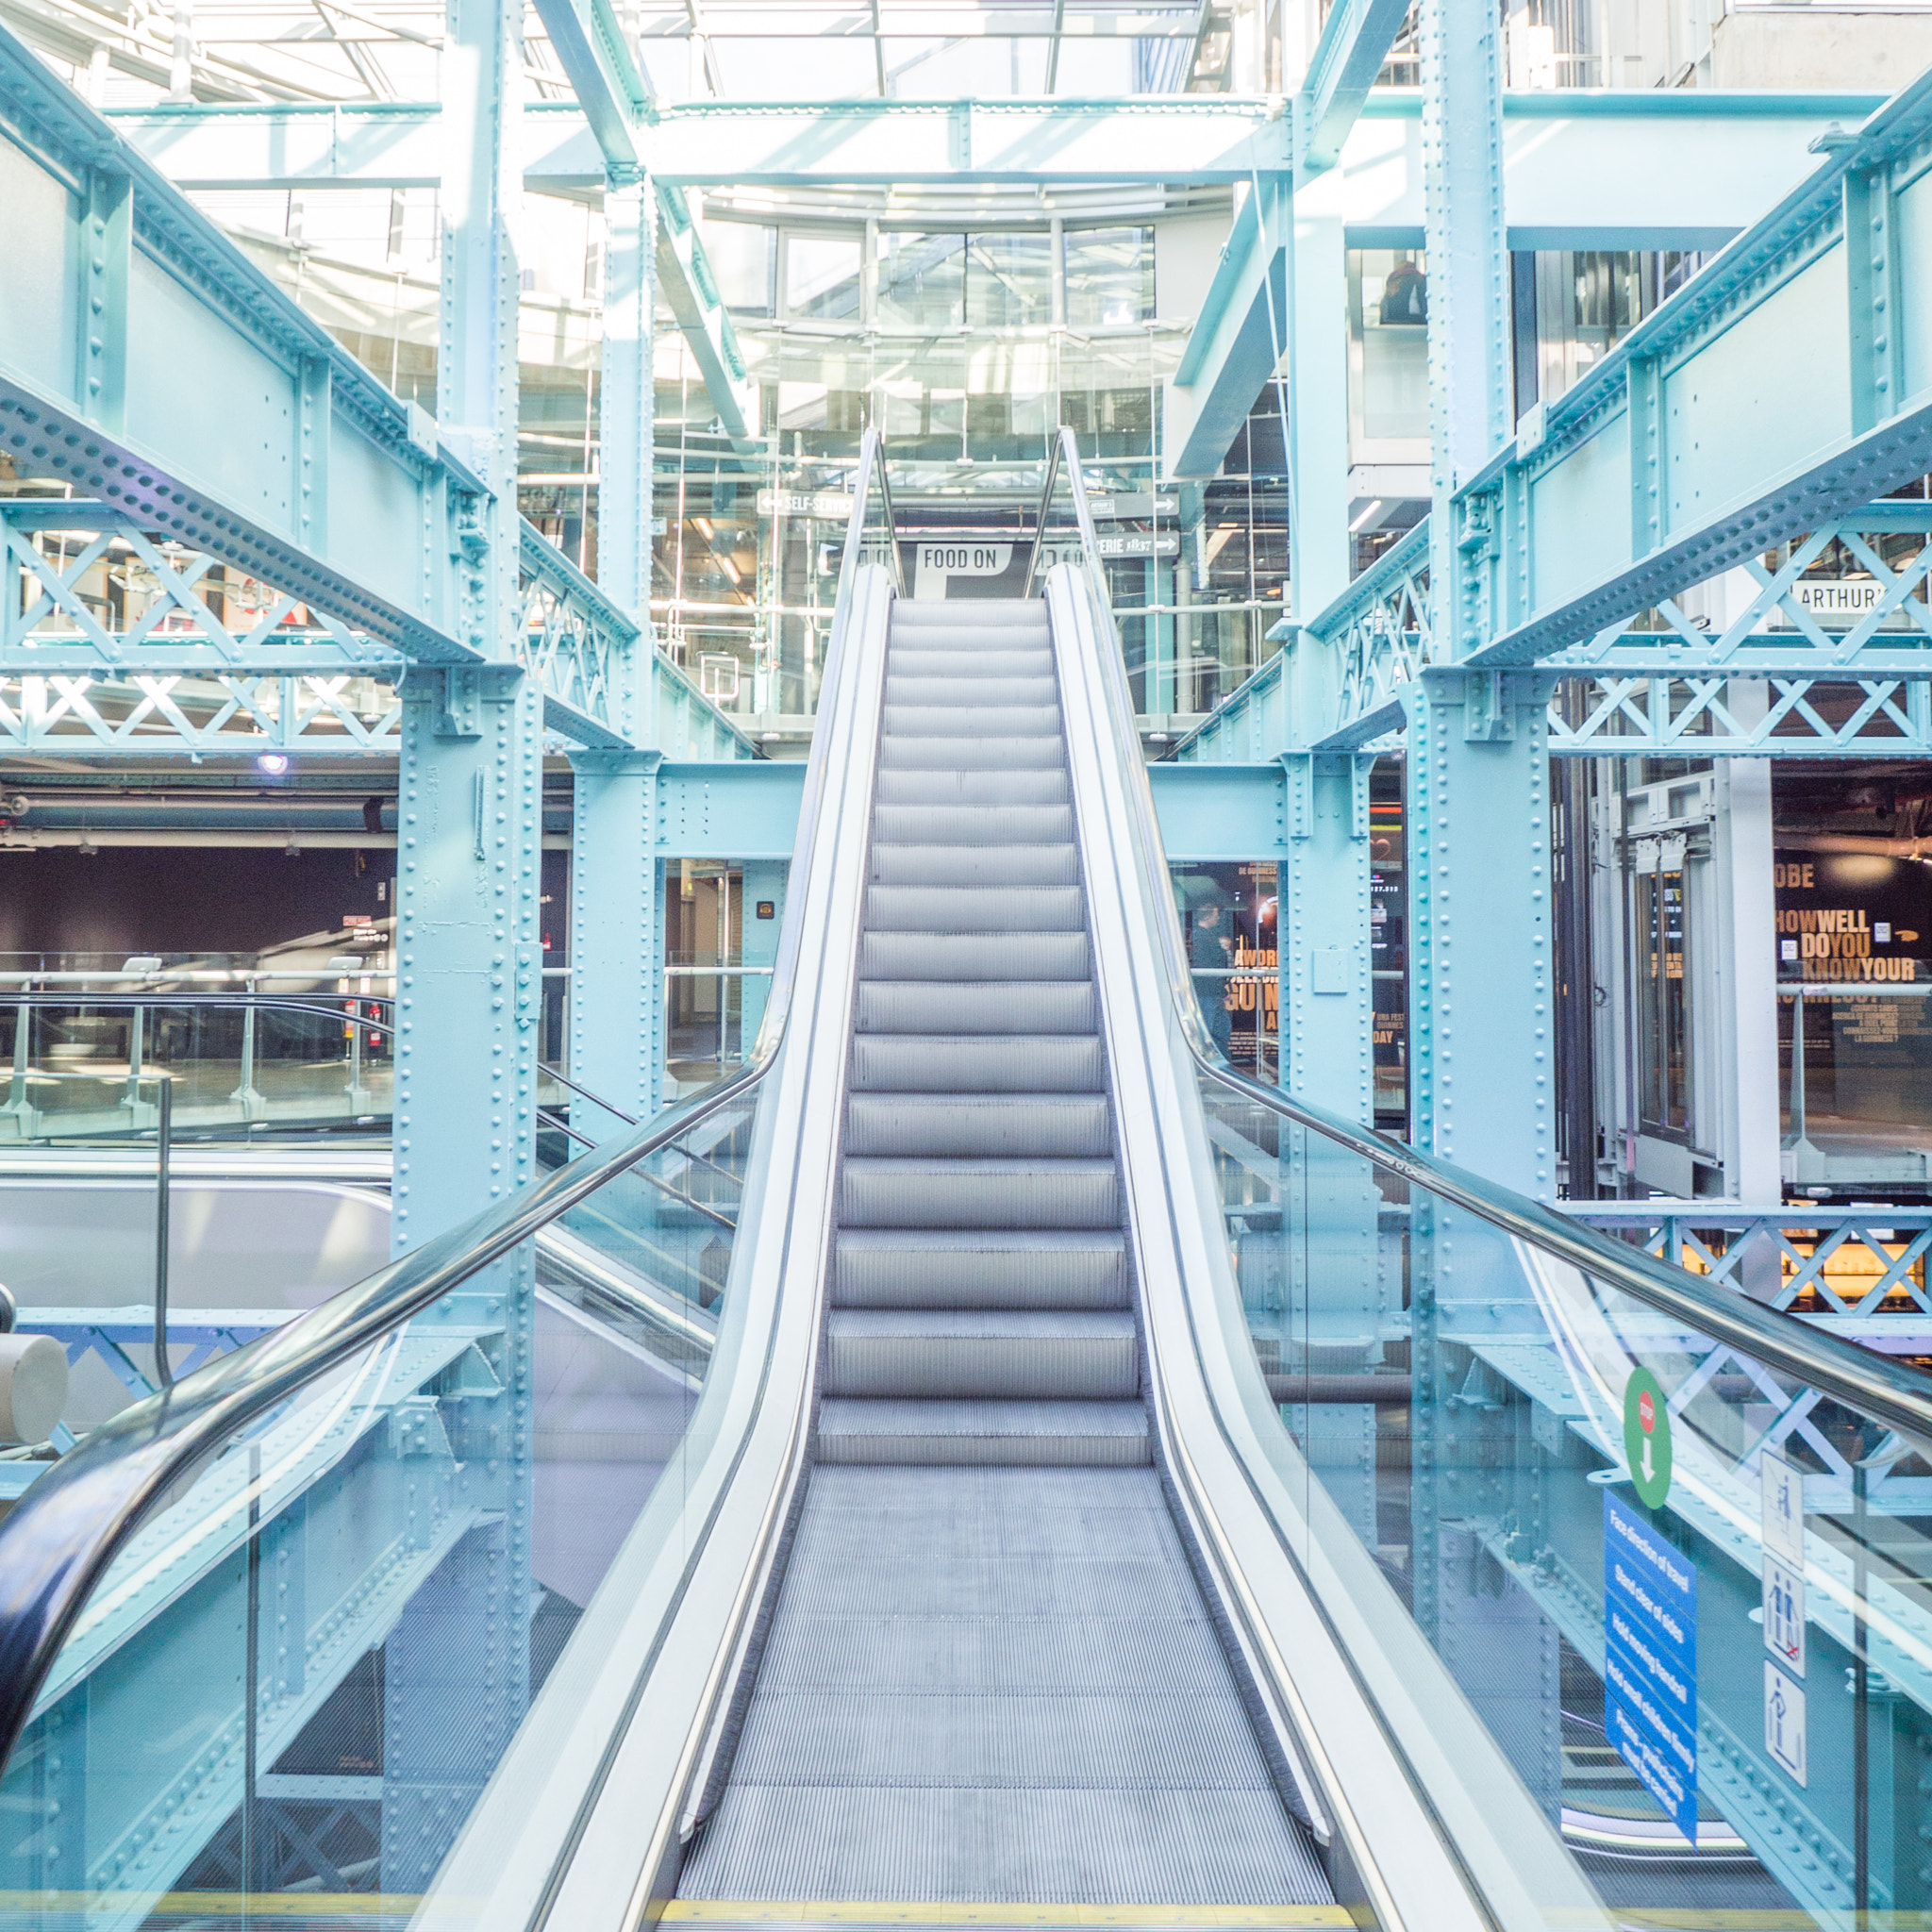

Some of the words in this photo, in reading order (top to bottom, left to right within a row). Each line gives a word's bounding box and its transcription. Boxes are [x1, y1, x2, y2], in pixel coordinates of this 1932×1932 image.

[924, 549, 967, 568] FOOD
[974, 549, 996, 568] ON
[1097, 539, 1124, 554] ERIE
[1126, 539, 1152, 552] 1837
[1802, 589, 1888, 608] ARTHUR'
[1817, 909, 1871, 933] WELL
[1801, 933, 1830, 958] DO
[1828, 933, 1871, 958] YOU
[1803, 958, 1861, 981] KNOW
[1860, 957, 1915, 981] YOUR
[1610, 1509, 1627, 1537] Face
[1627, 1526, 1658, 1565] direction
[1658, 1556, 1667, 1573] of
[1667, 1560, 1689, 1593] travel
[1615, 1564, 1636, 1596] Stand
[1636, 1588, 1654, 1614] clear
[1654, 1606, 1662, 1623] of
[1662, 1614, 1684, 1643] sides
[1613, 1613, 1629, 1642] Hold
[1629, 1634, 1656, 1674] moving
[1656, 1658, 1687, 1704] handrail
[1607, 1658, 1624, 1688] Hold
[1623, 1680, 1642, 1709] small
[1642, 1701, 1673, 1743] children
[1672, 1732, 1694, 1774] firmly
